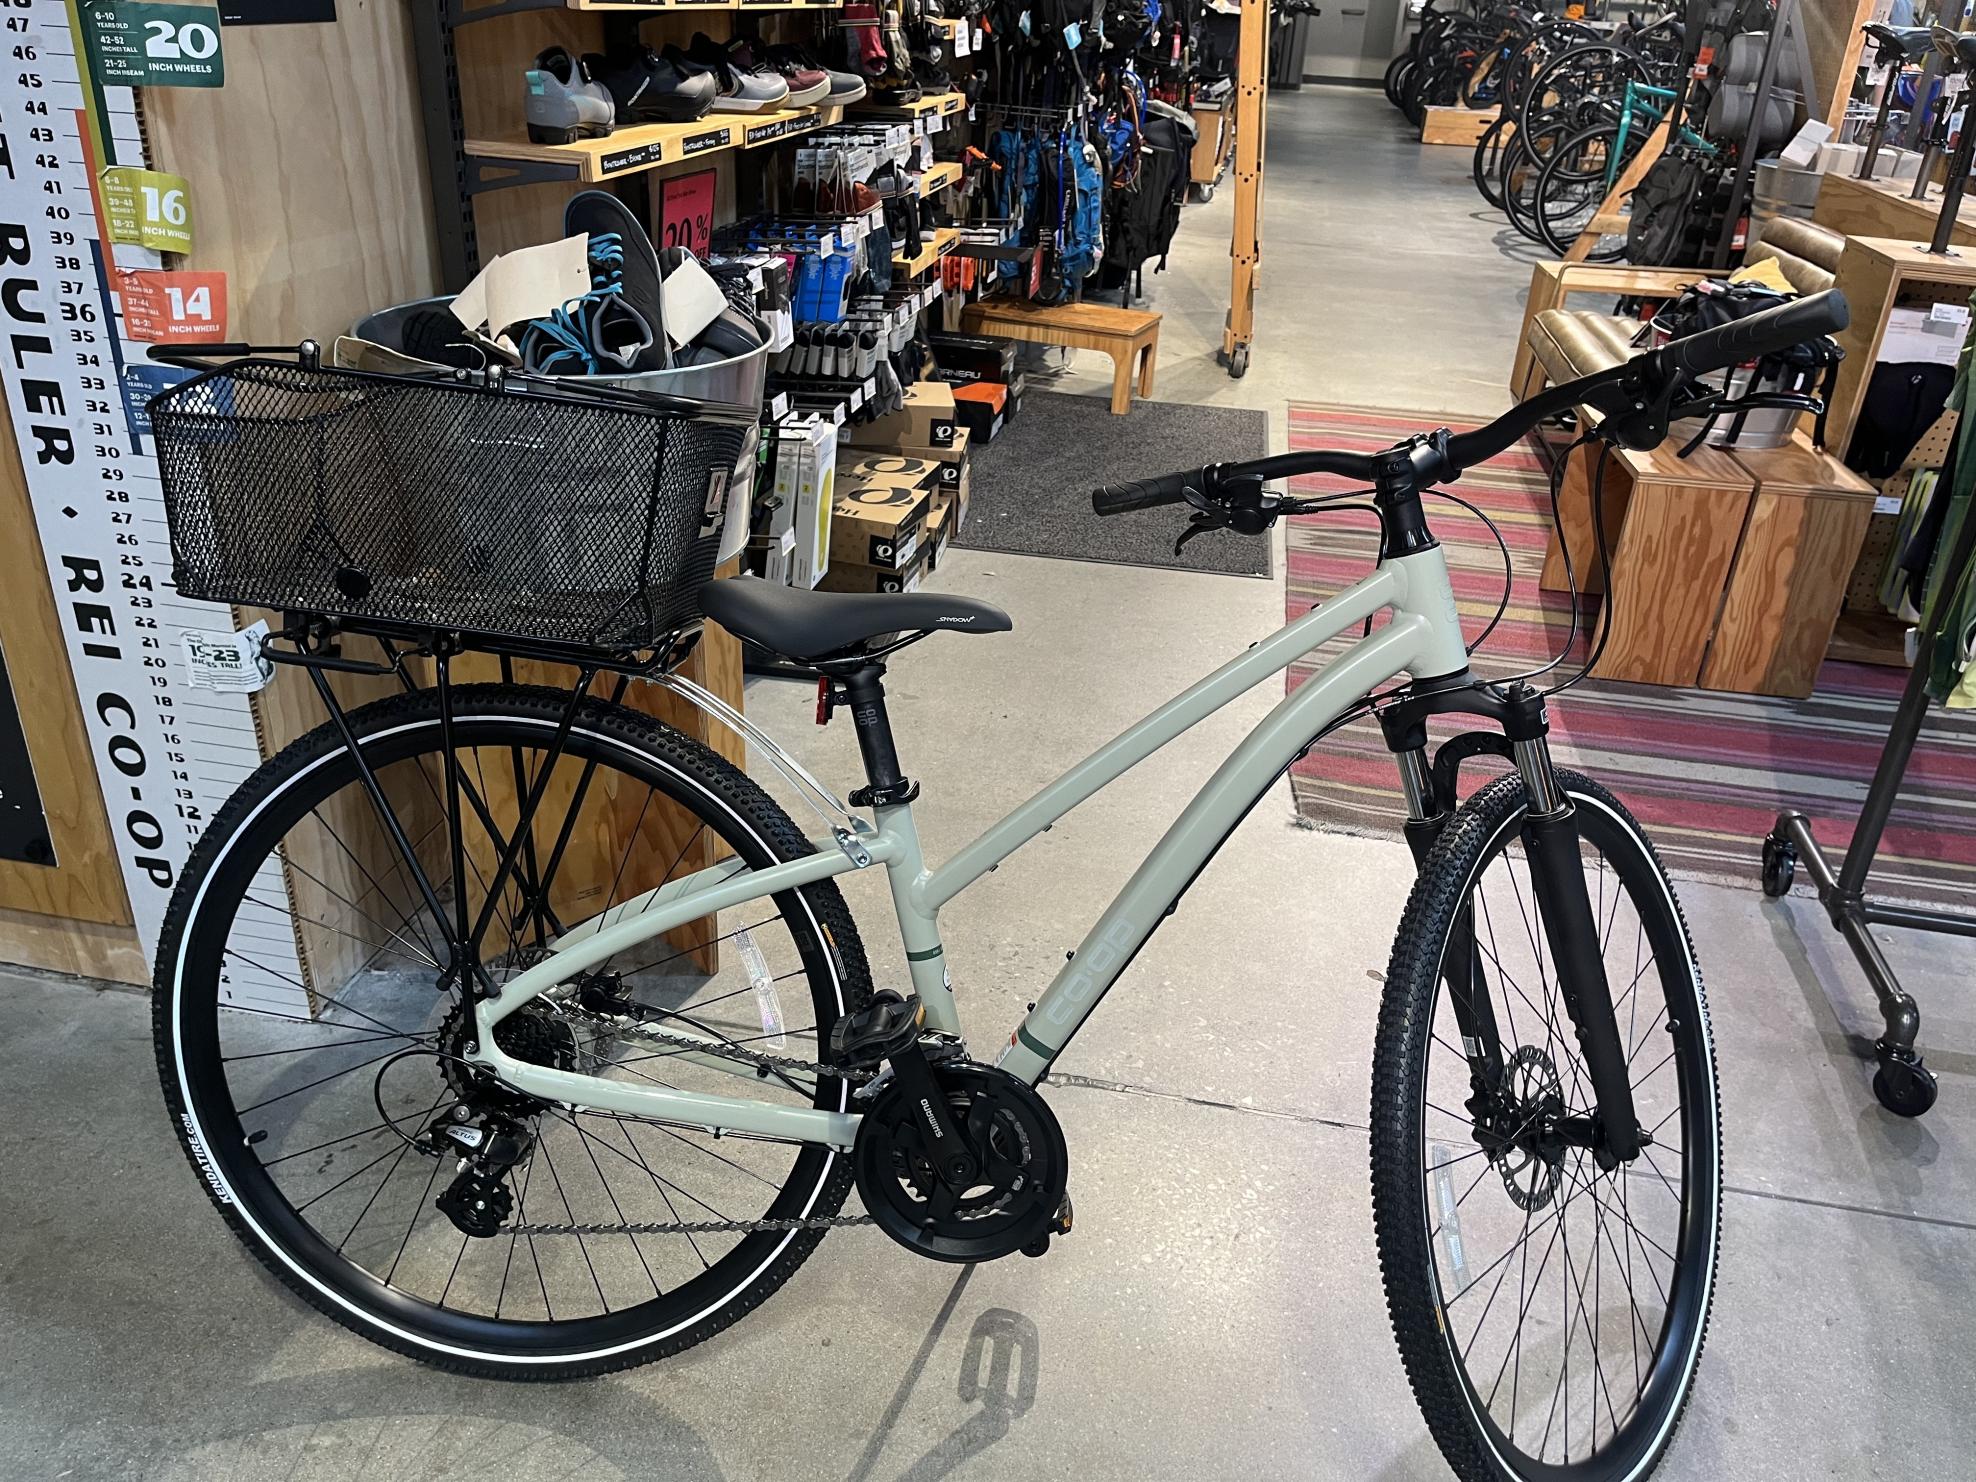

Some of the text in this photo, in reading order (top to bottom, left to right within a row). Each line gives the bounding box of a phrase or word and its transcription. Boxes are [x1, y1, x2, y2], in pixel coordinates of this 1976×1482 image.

[95, 12, 114, 20] 6-10
[7, 17, 28, 32] 47
[100, 36, 124, 45] 42-52
[143, 20, 219, 60] 20
[13, 46, 36, 60] 46
[104, 59, 127, 68] 21-25
[148, 62, 213, 74] INCH WHEELS
[18, 74, 42, 88] 45
[25, 101, 47, 115] 44
[30, 128, 53, 142] 43
[36, 154, 59, 168] 42
[44, 181, 61, 194] 41
[140, 186, 187, 226] 16
[46, 206, 69, 220] 40
[141, 226, 166, 236] INCH
[50, 231, 74, 245] 39
[55, 256, 80, 270] 38
[61, 281, 83, 294] 37
[164, 286, 212, 321] 14
[60, 302, 95, 322] 36
[71, 329, 95, 342] 35
[168, 325, 193, 334] INCH
[77, 353, 99, 366] 34
[81, 377, 105, 390] 33
[86, 400, 110, 413] 32
[134, 412, 150, 420] 12-1
[93, 423, 112, 435] 31
[95, 445, 120, 458] 30
[102, 468, 123, 480] 29
[106, 490, 129, 502] 28
[112, 512, 131, 524] 27
[117, 534, 138, 545] 26
[0, 223, 174, 889] RULER REI CO-OP
[121, 555, 143, 566] 25
[121, 573, 153, 591] 24
[131, 596, 152, 608] 23
[135, 617, 157, 628] 22
[142, 637, 159, 648] 21
[144, 656, 166, 668] 20
[150, 676, 167, 686] 19
[154, 696, 172, 706] 18
[159, 715, 174, 725] 17
[164, 734, 180, 744] 16
[167, 752, 184, 762] 15
[172, 771, 188, 781] 14
[176, 789, 193, 799] 13
[175, 804, 201, 820] 12
[187, 825, 198, 834] 11
[920, 1098, 944, 1138] SHIMANO
[449, 1129, 478, 1142] ALTUS
[181, 1113, 233, 1204] KENDATIRE.COM
